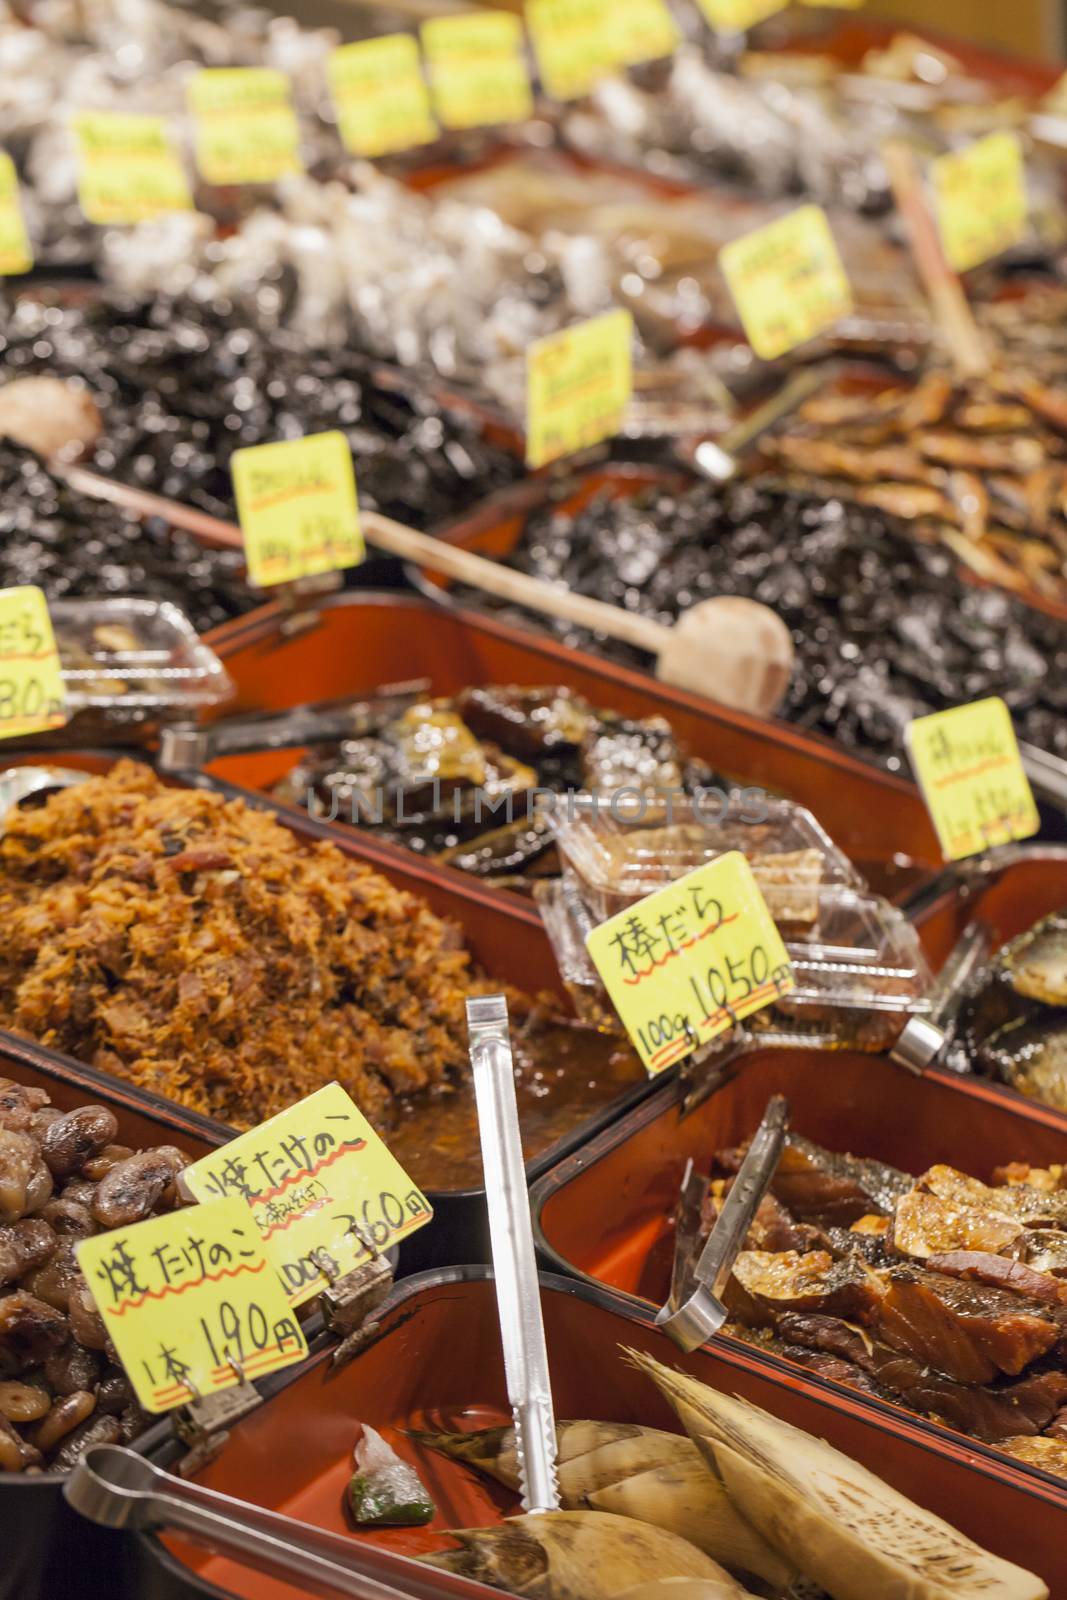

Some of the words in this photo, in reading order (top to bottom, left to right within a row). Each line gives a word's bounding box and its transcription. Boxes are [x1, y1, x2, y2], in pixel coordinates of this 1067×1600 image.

[608, 886, 723, 975] 棒だら
[689, 945, 793, 1021] 1050円
[637, 1013, 694, 1055] 100g
[205, 1114, 363, 1206] 焼たけのこ
[331, 1190, 431, 1258] 360円
[97, 1229, 255, 1302] 焼たけのこ
[200, 1301, 303, 1366] 190円
